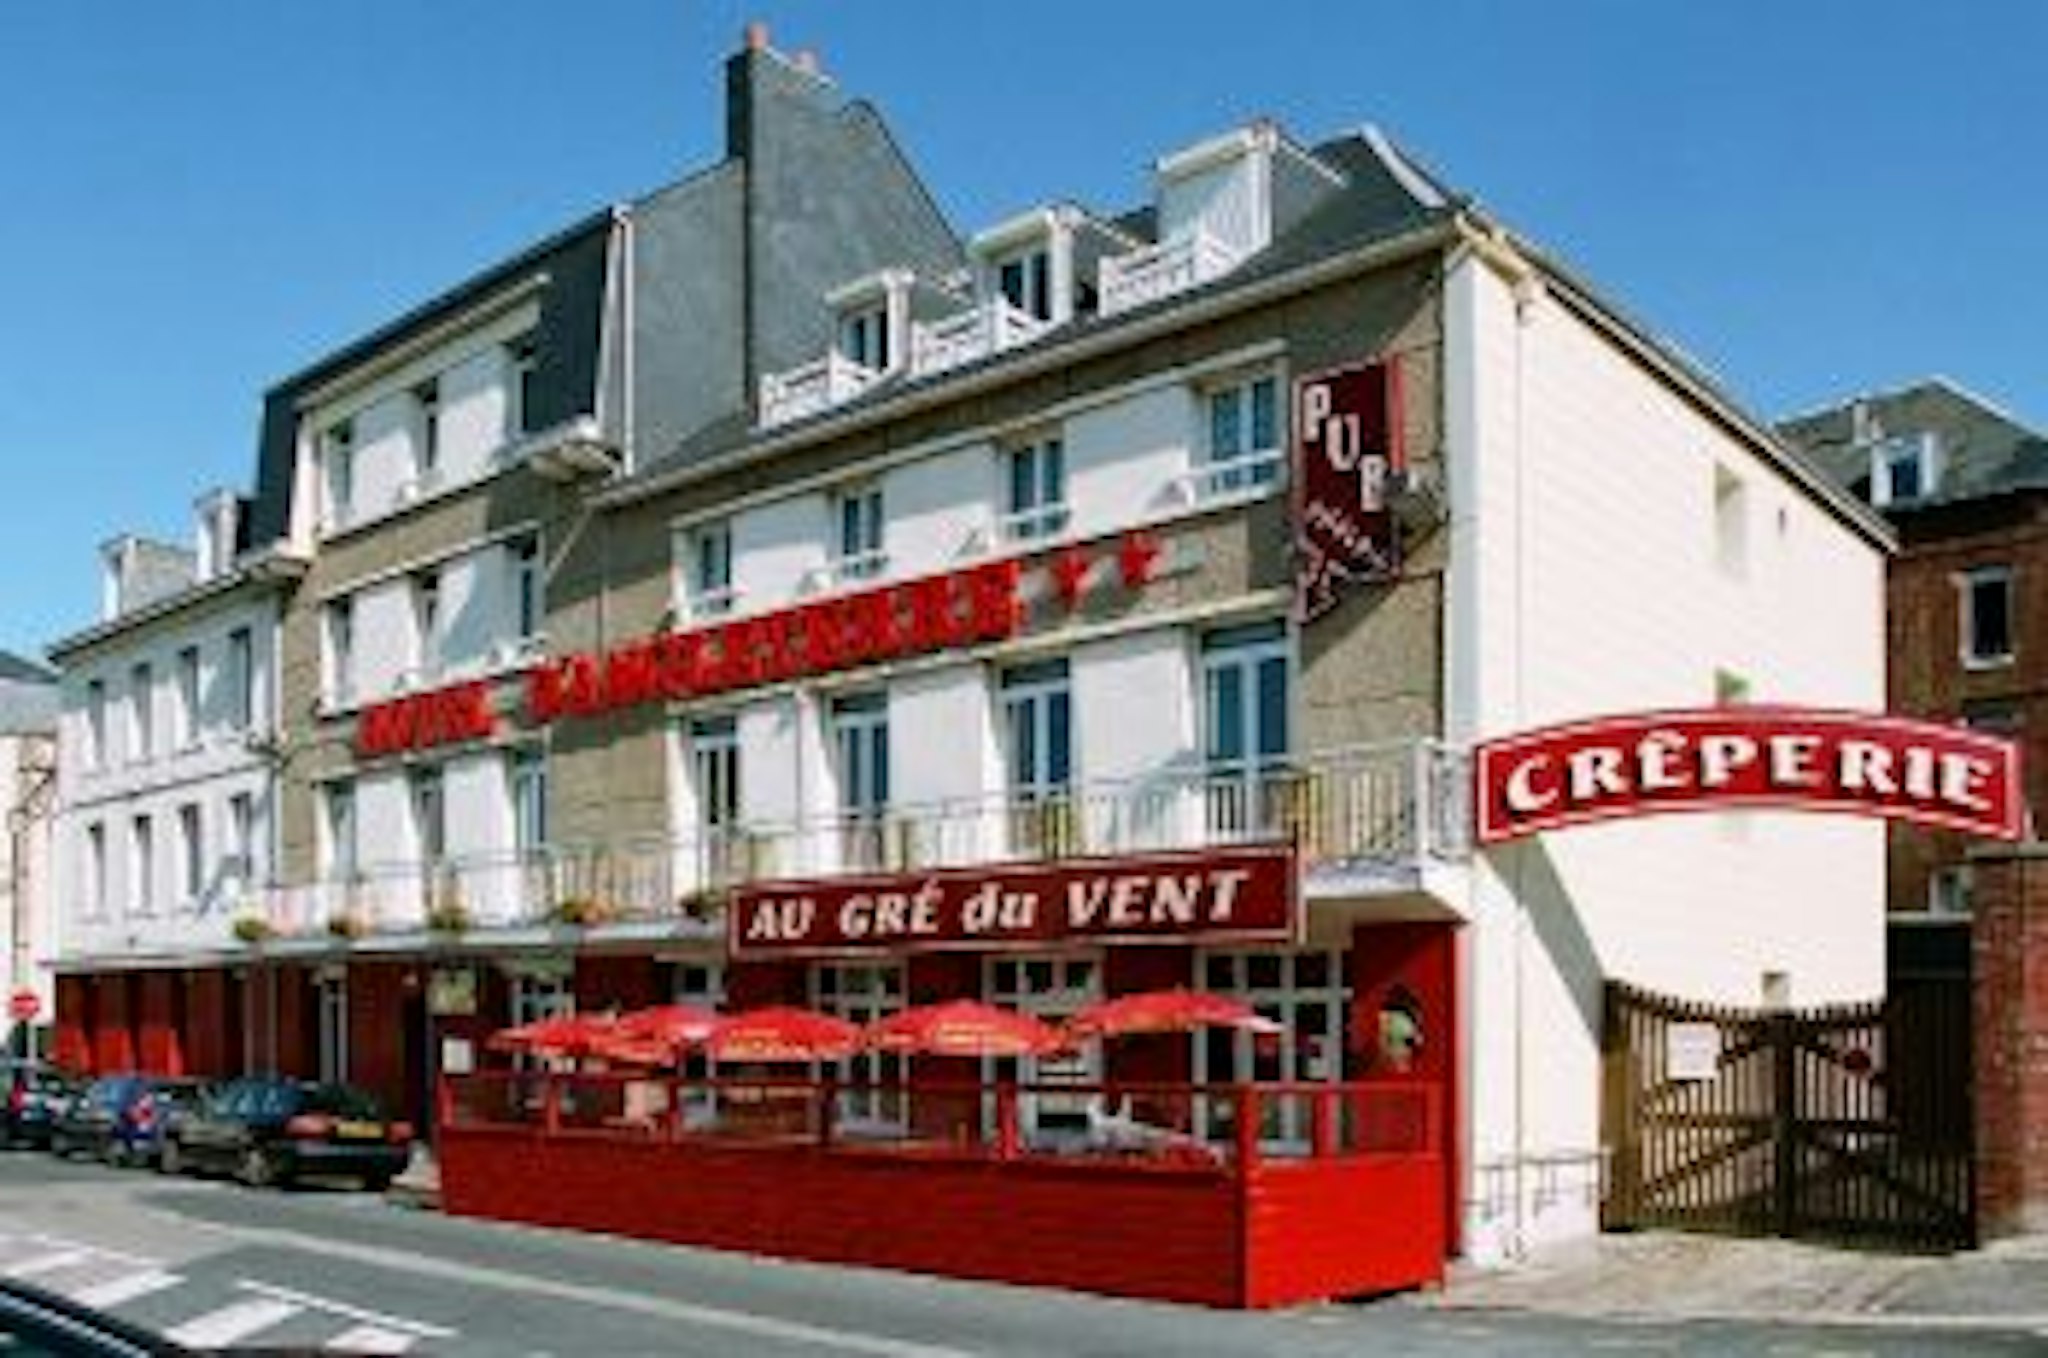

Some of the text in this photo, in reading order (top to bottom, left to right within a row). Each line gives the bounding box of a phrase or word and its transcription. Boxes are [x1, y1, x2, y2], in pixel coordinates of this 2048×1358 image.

[1303, 383, 1388, 513] PUB
[1506, 729, 1993, 811] CRÊPERIE
[747, 870, 1250, 940] AU GRÉ du VENT
